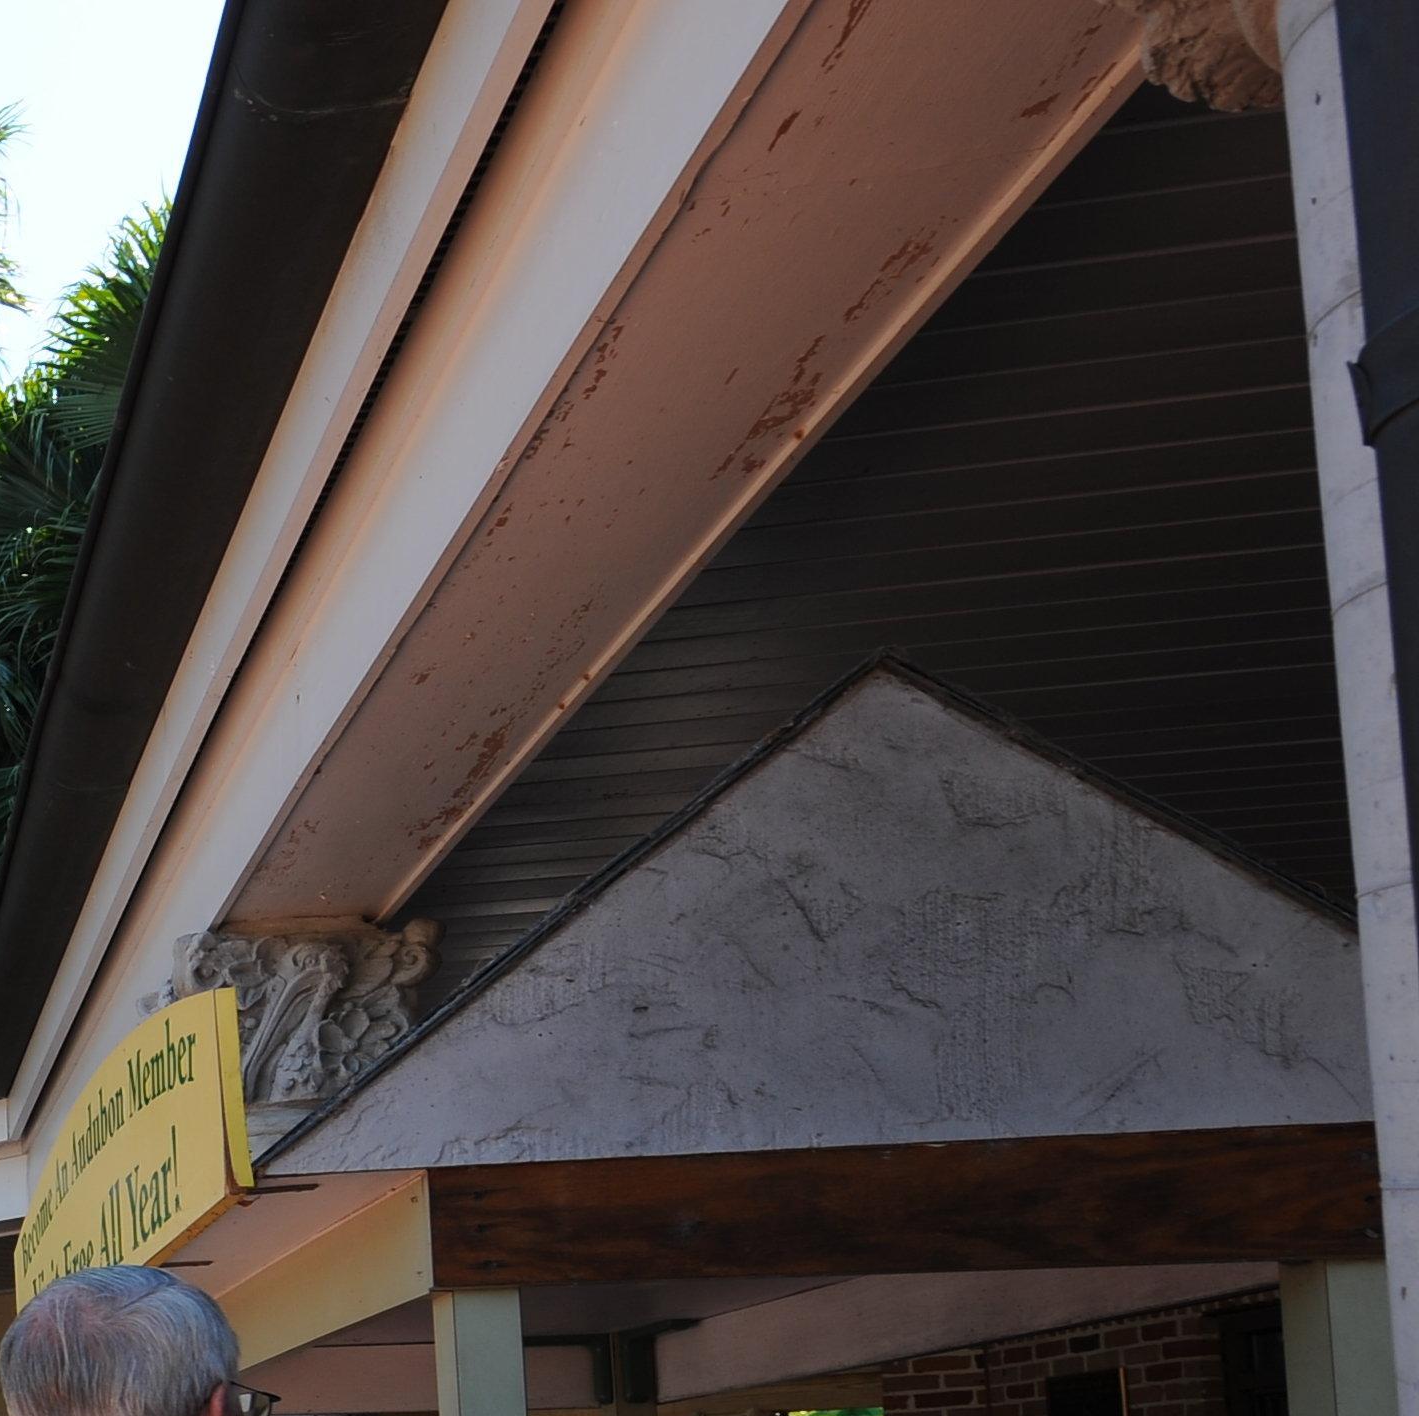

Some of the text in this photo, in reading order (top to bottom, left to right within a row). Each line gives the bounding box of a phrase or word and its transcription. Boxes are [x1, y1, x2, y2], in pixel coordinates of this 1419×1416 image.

[21, 1188, 54, 1279] Become
[55, 1157, 70, 1211] An
[71, 1085, 125, 1185] Audubon
[127, 1017, 197, 1119] Member
[100, 1178, 125, 1269] All
[124, 1124, 183, 1252] Year!
